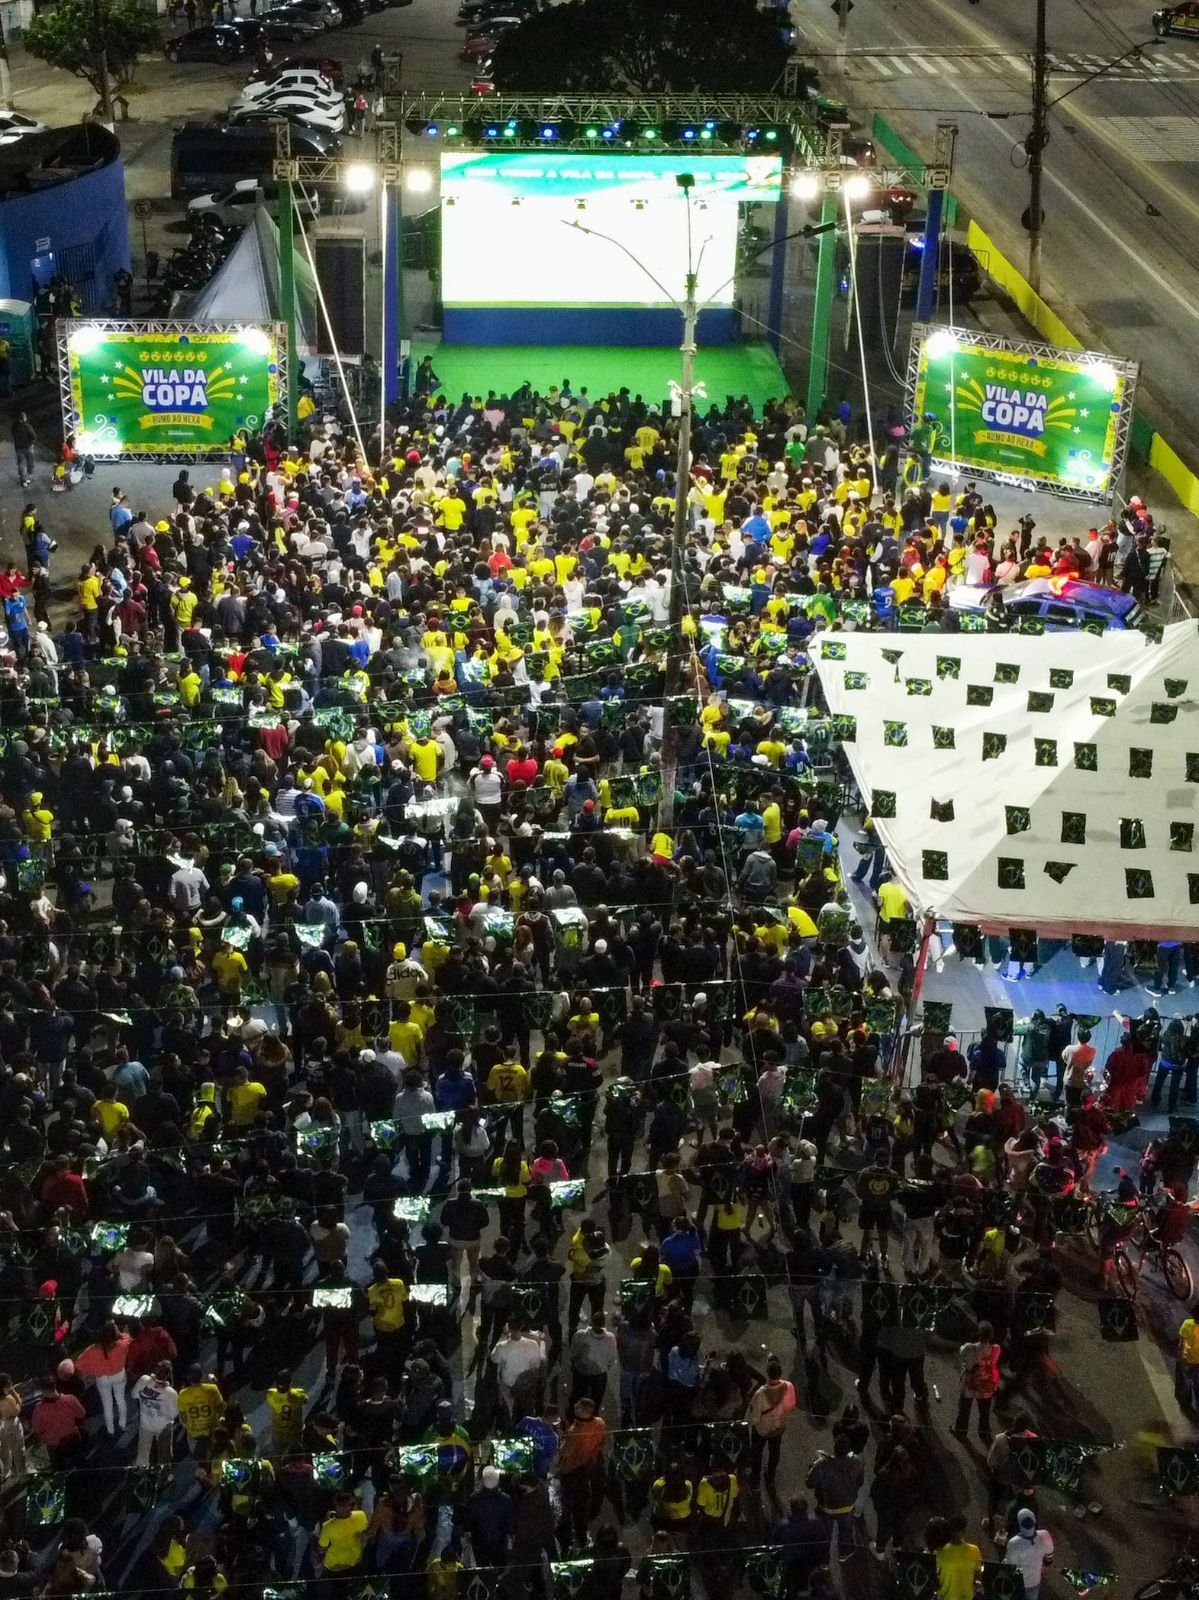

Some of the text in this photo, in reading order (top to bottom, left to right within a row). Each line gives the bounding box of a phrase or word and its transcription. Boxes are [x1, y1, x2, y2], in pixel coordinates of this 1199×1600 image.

[141, 369, 207, 384] VILA DA
[142, 384, 208, 406] COPA
[985, 384, 1048, 409] VILA DA
[152, 414, 201, 424] RUMO AO HEXA
[981, 401, 1045, 432] COPA
[986, 432, 1034, 448] RUMO AO HEXA
[744, 461, 754, 472] 10
[884, 596, 892, 609] 9
[816, 729, 826, 739] 11
[500, 1076, 515, 1092] 12
[188, 1404, 214, 1419] 99
